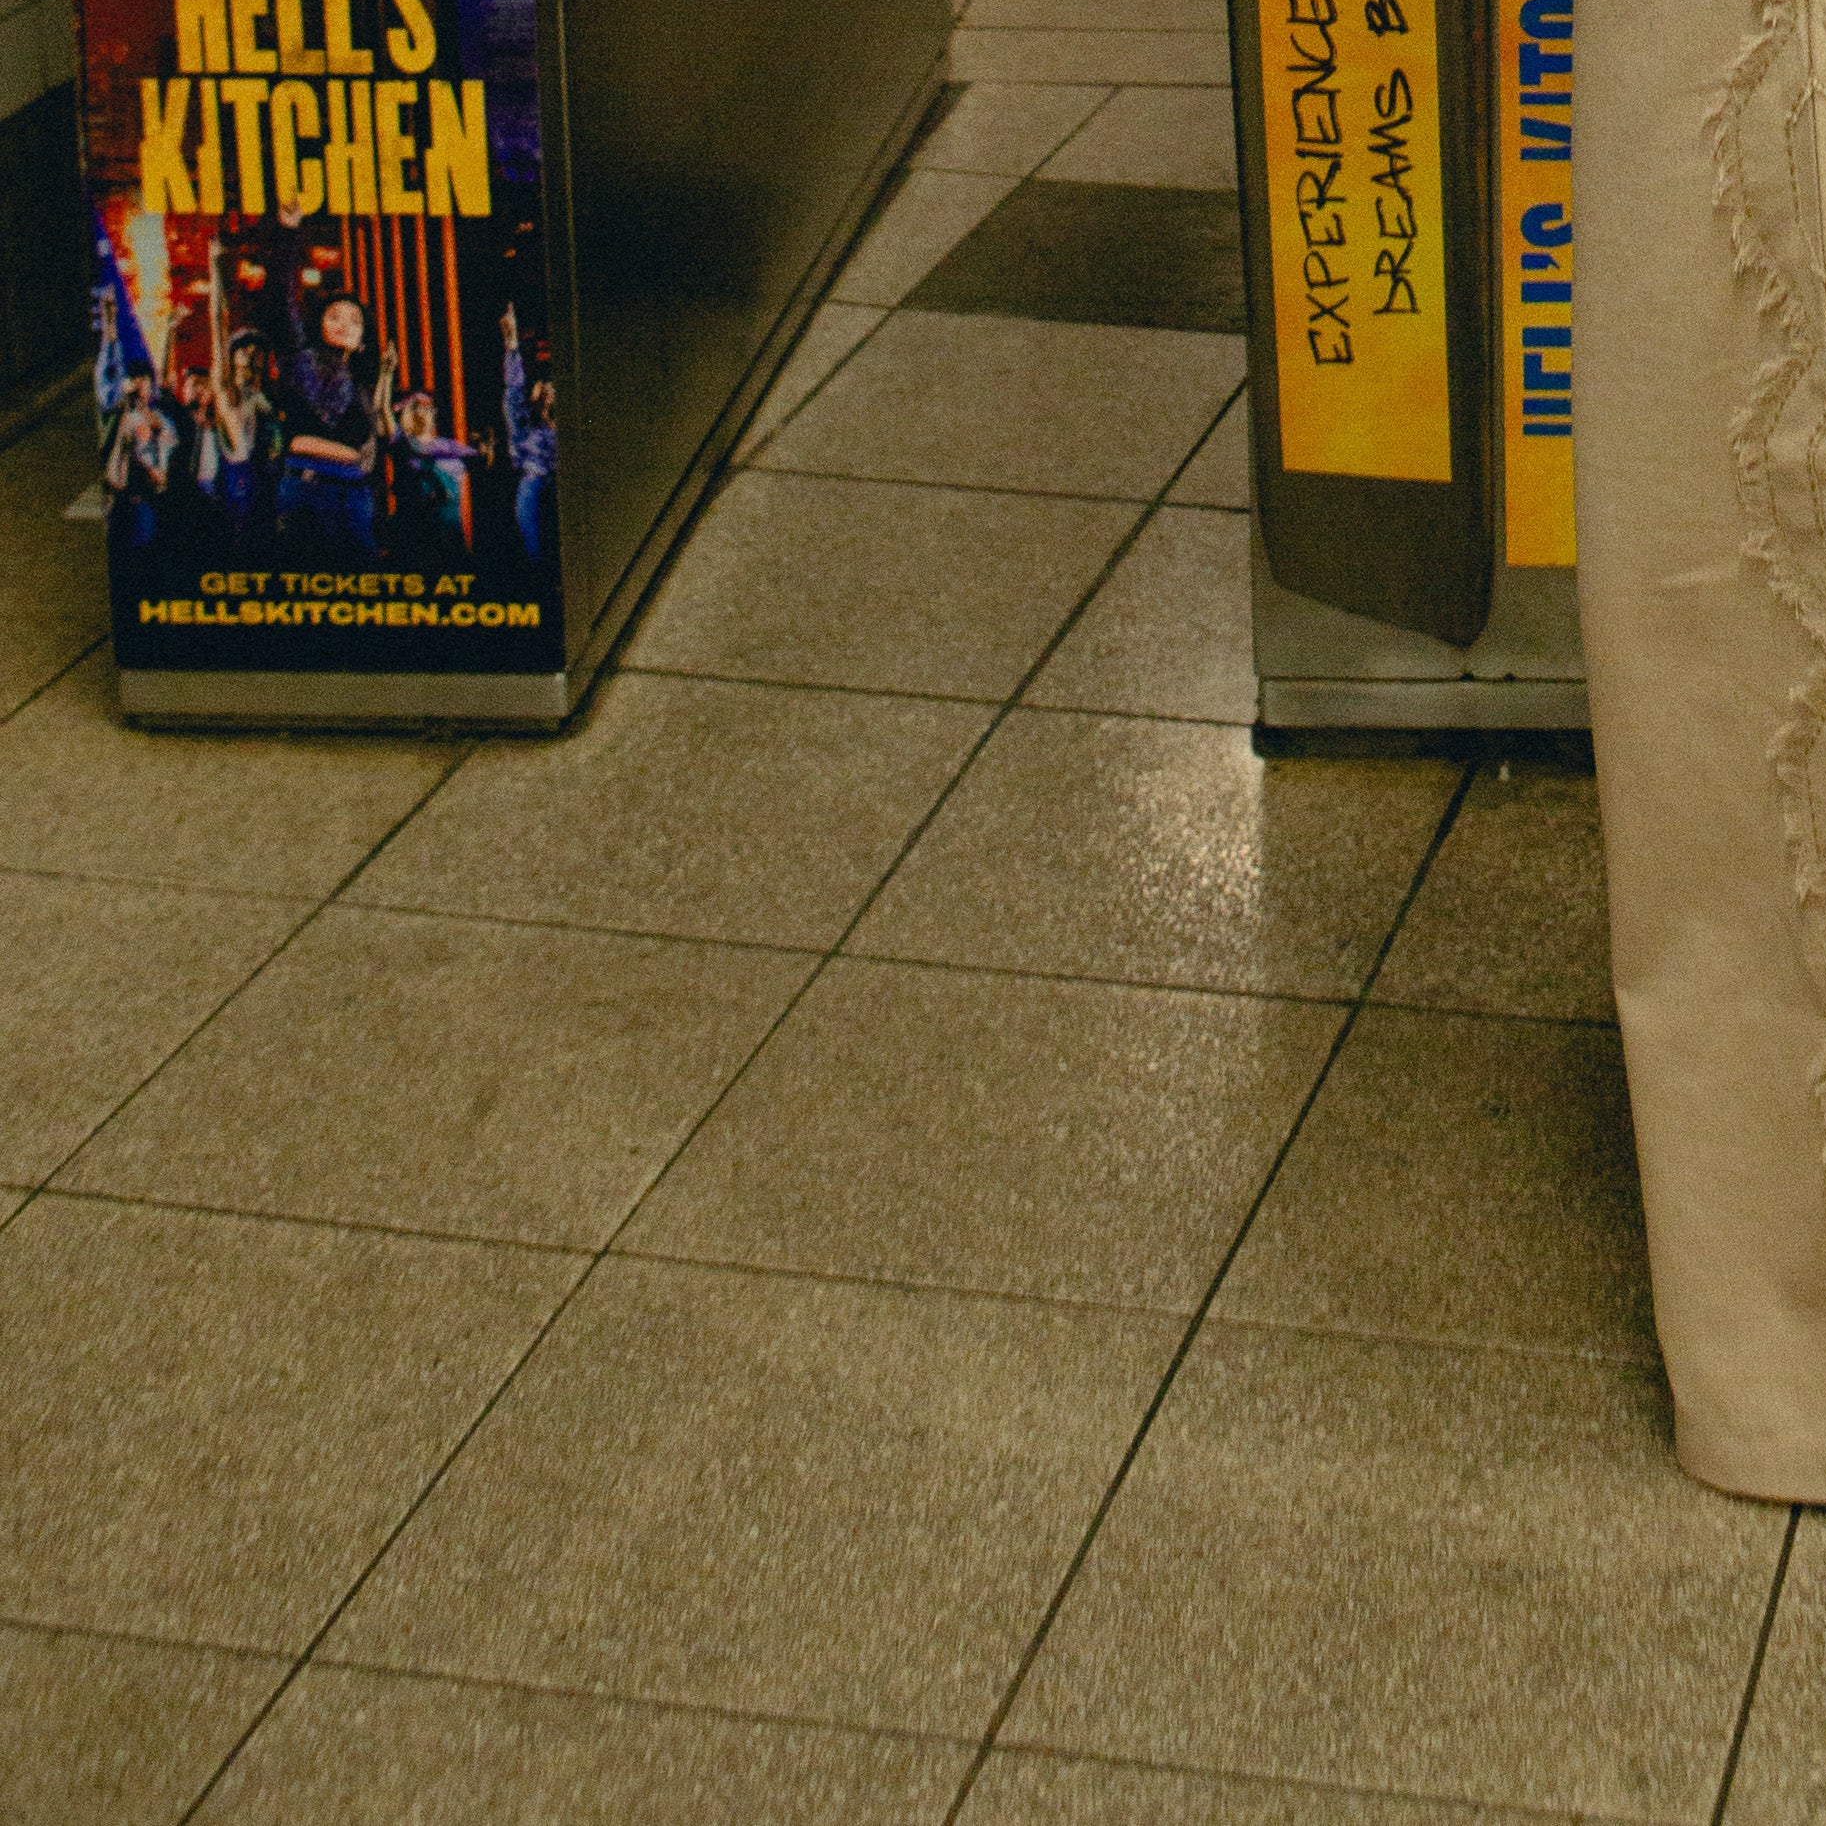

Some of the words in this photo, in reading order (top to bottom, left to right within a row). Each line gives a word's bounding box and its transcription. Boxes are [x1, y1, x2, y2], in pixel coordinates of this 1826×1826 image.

[139, 77, 492, 217] KITCHEN
[1367, 68, 1421, 316] DREAMS
[138, 599, 541, 628] HELLSKITCHEN.COM
[200, 571, 271, 596] GET
[280, 571, 426, 597] TICKETS
[434, 573, 476, 596] AT
